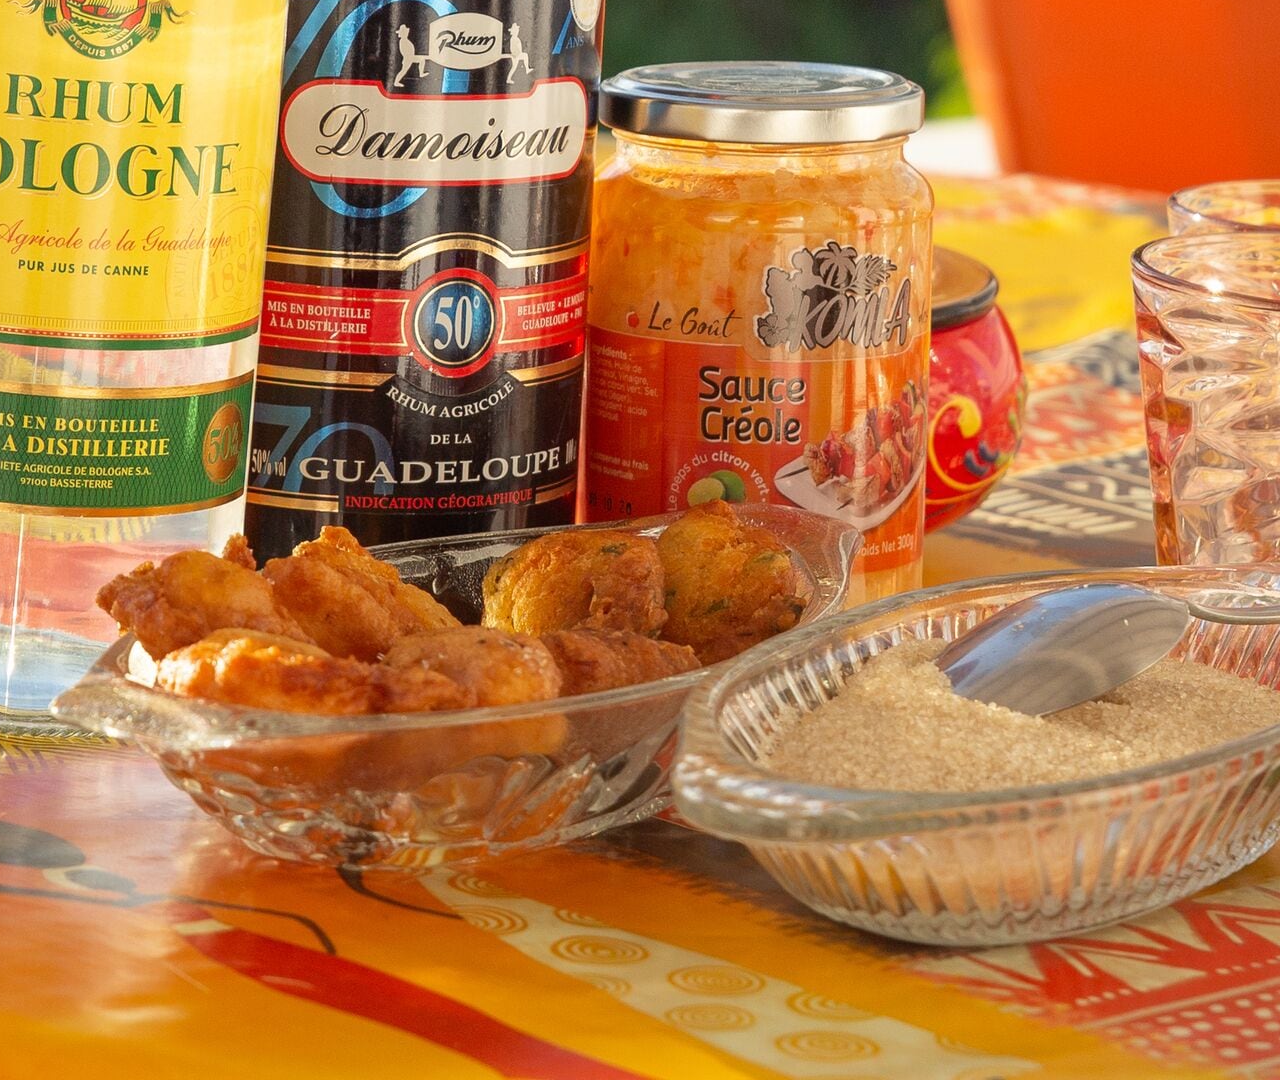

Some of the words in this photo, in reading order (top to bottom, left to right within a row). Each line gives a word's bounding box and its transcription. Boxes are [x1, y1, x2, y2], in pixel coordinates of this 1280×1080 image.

[68, 34, 106, 57] DEPUIS
[110, 38, 134, 56] 1887
[437, 29, 496, 55] Rhum
[3, 71, 187, 125] RHUM
[315, 103, 570, 161] Damoiseau
[88, 227, 111, 251] de
[115, 228, 136, 251] la
[18, 258, 45, 273] PUR
[50, 260, 76, 274] JUS
[82, 263, 98, 276] DE
[104, 264, 150, 277] CANNE
[267, 300, 288, 312] MIS
[290, 303, 305, 315] EN
[307, 305, 371, 319] BOUTEILLE
[517, 301, 556, 316] BELLEVUE
[648, 300, 673, 332] Le
[680, 308, 743, 338] Goût
[280, 317, 294, 329] LA
[296, 319, 368, 334] DISTILLERIE
[433, 294, 481, 351] 50°
[522, 312, 569, 330] GUADELOUPE
[698, 364, 806, 403] Sauce
[385, 385, 437, 417] RHUM
[439, 381, 515, 418] AGRICOLE
[22, 415, 48, 431] EN
[55, 418, 160, 433] BOUTEILLE
[699, 404, 803, 444] Créole
[26, 435, 170, 457] DISTILLERIE
[430, 433, 451, 445] DE
[454, 433, 473, 445] LA
[23, 463, 72, 475] AGRICOLE
[74, 466, 87, 476] DE
[89, 466, 134, 476] BOLOGNE
[135, 466, 152, 476] S.A.
[252, 448, 272, 475] 50%
[274, 456, 287, 477] vol
[299, 446, 561, 485] GUADELOUPE
[691, 453, 708, 467] du
[711, 450, 750, 471] citron
[20, 477, 48, 487] 97100
[670, 463, 692, 494] peps
[750, 469, 771, 496] vert
[345, 495, 435, 510] INDICATION
[437, 487, 532, 509] GÉOGRAPHIQUE
[667, 494, 678, 511] Le
